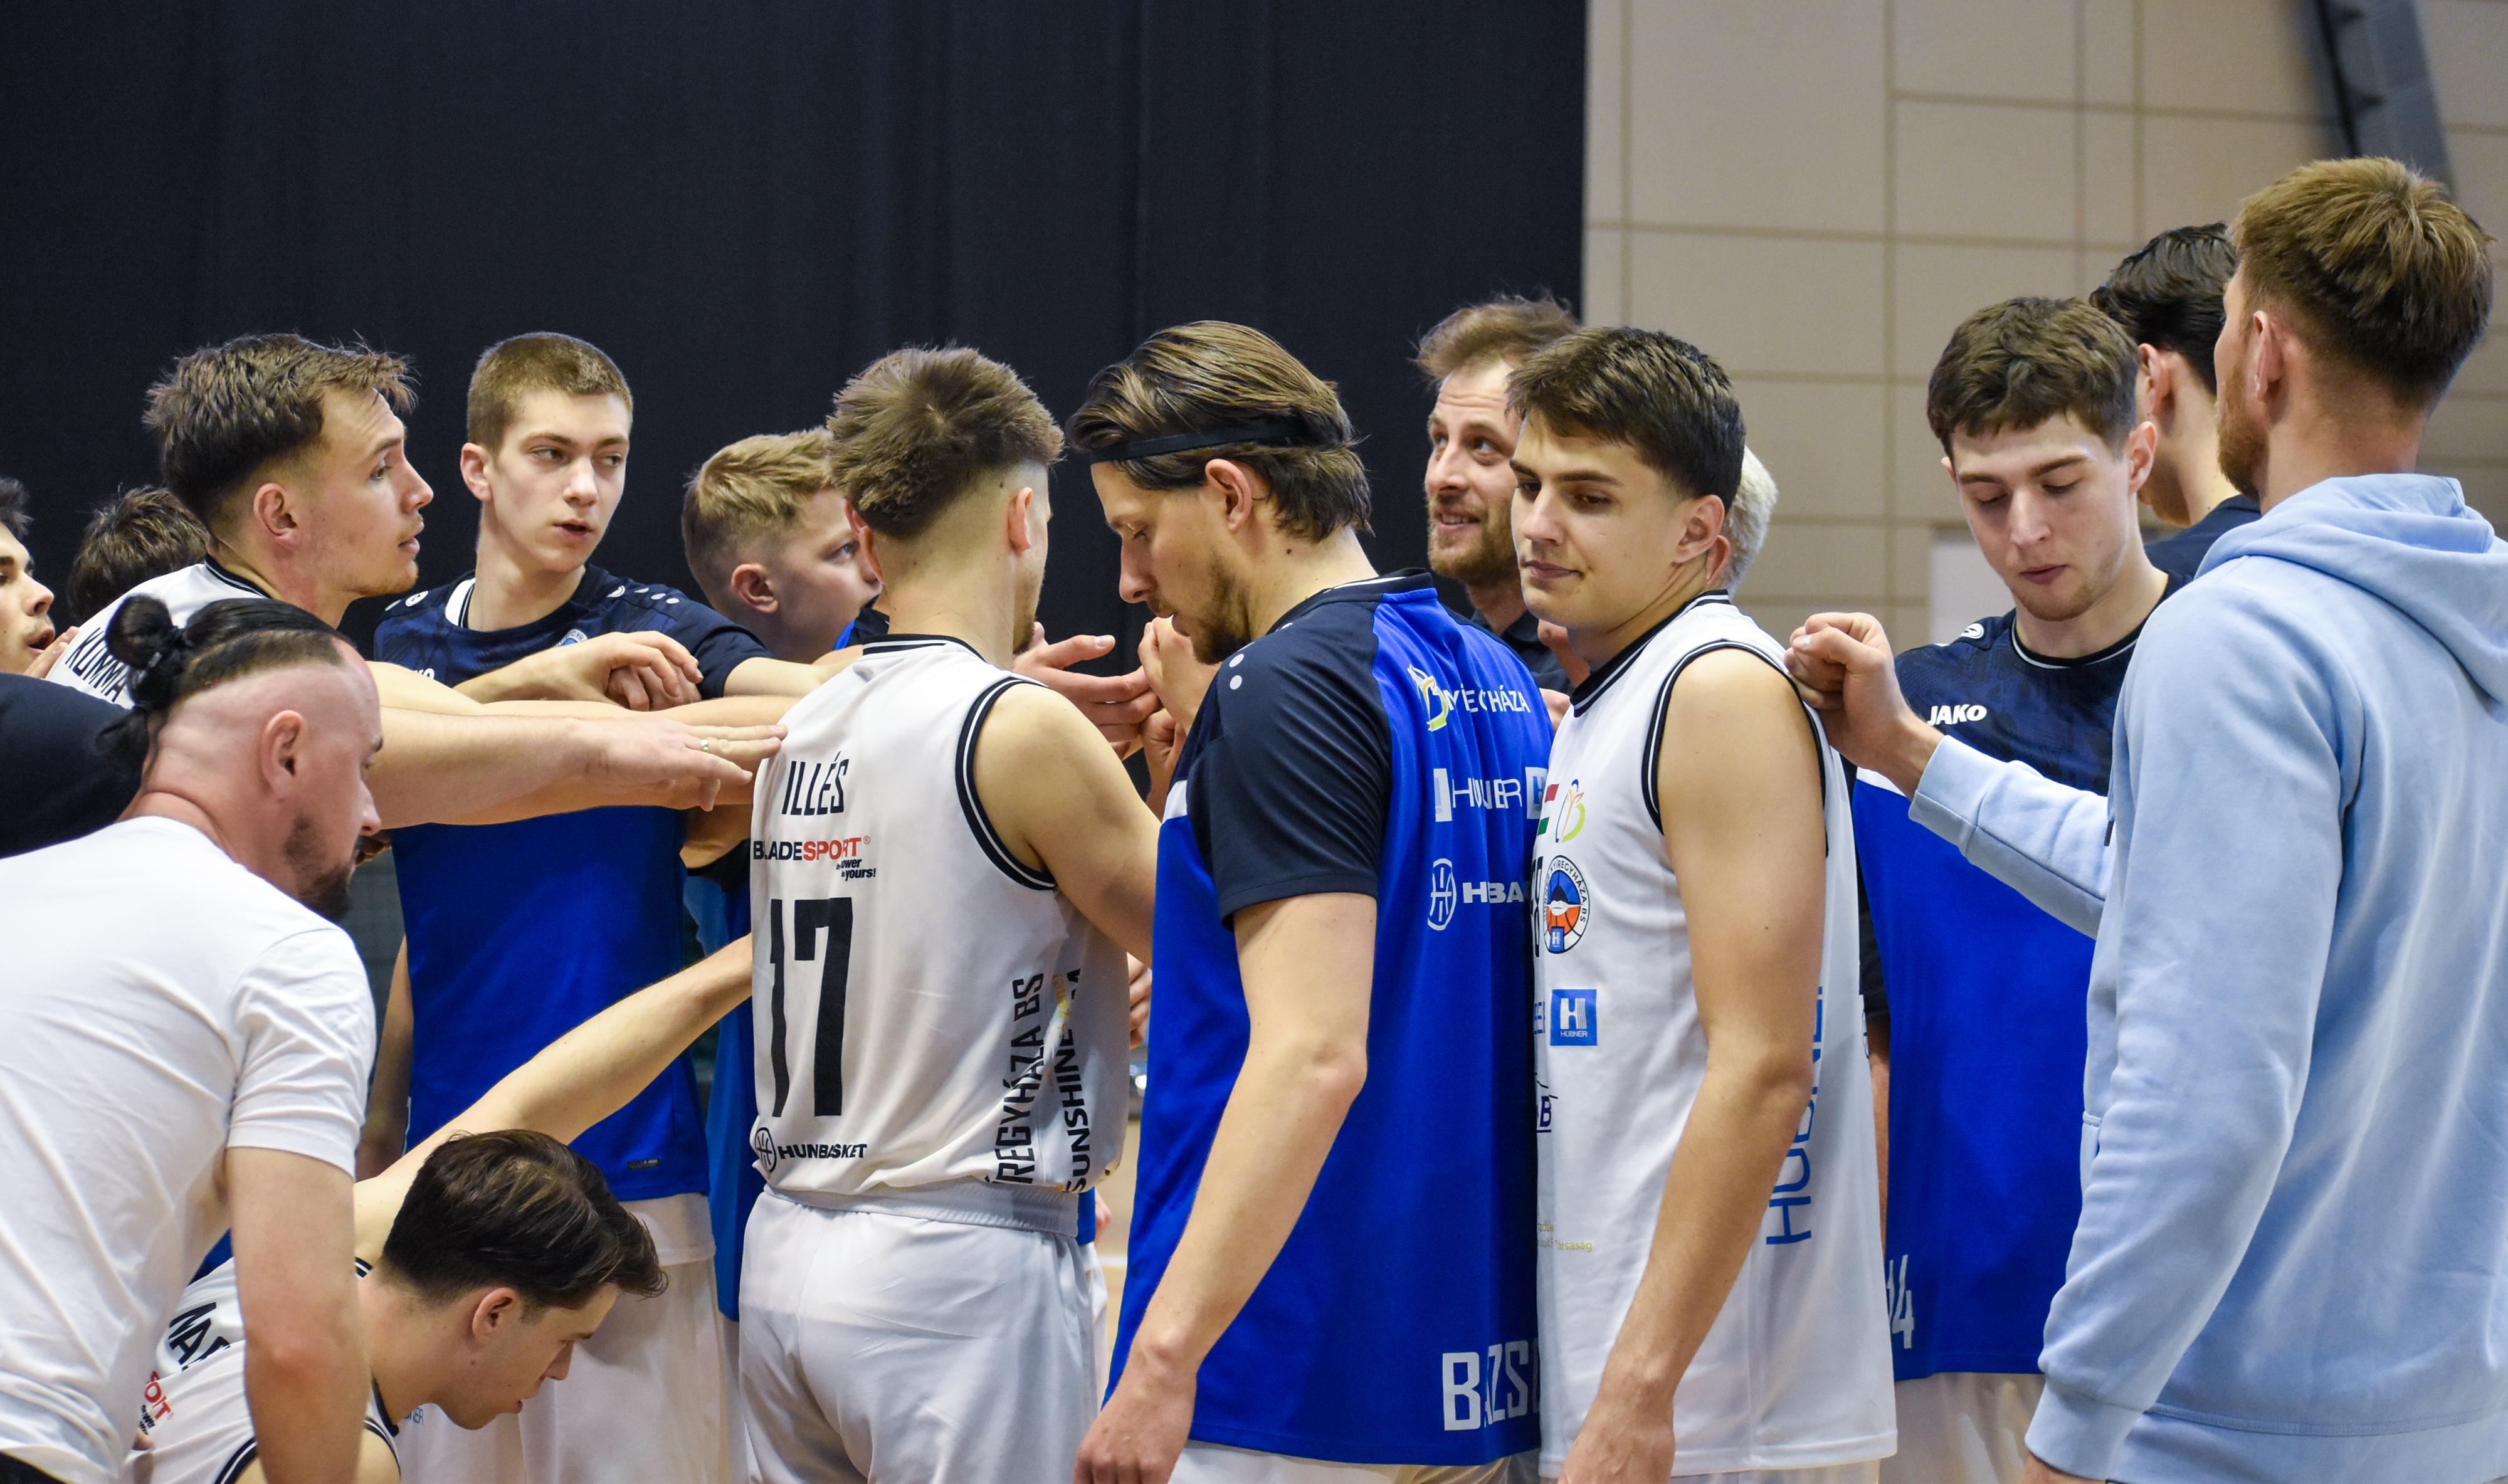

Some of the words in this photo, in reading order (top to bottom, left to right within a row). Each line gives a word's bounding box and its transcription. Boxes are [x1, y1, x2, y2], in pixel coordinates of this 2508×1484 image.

[1927, 703, 1988, 726] JAKO
[781, 751, 849, 816] ILLÉS
[845, 868, 877, 881] yours!
[1579, 907, 1588, 923] BS
[770, 897, 853, 1118] 17
[1012, 972, 1045, 1022] BS
[1887, 1254, 1915, 1349] 14
[1442, 1339, 1539, 1431] BZS
